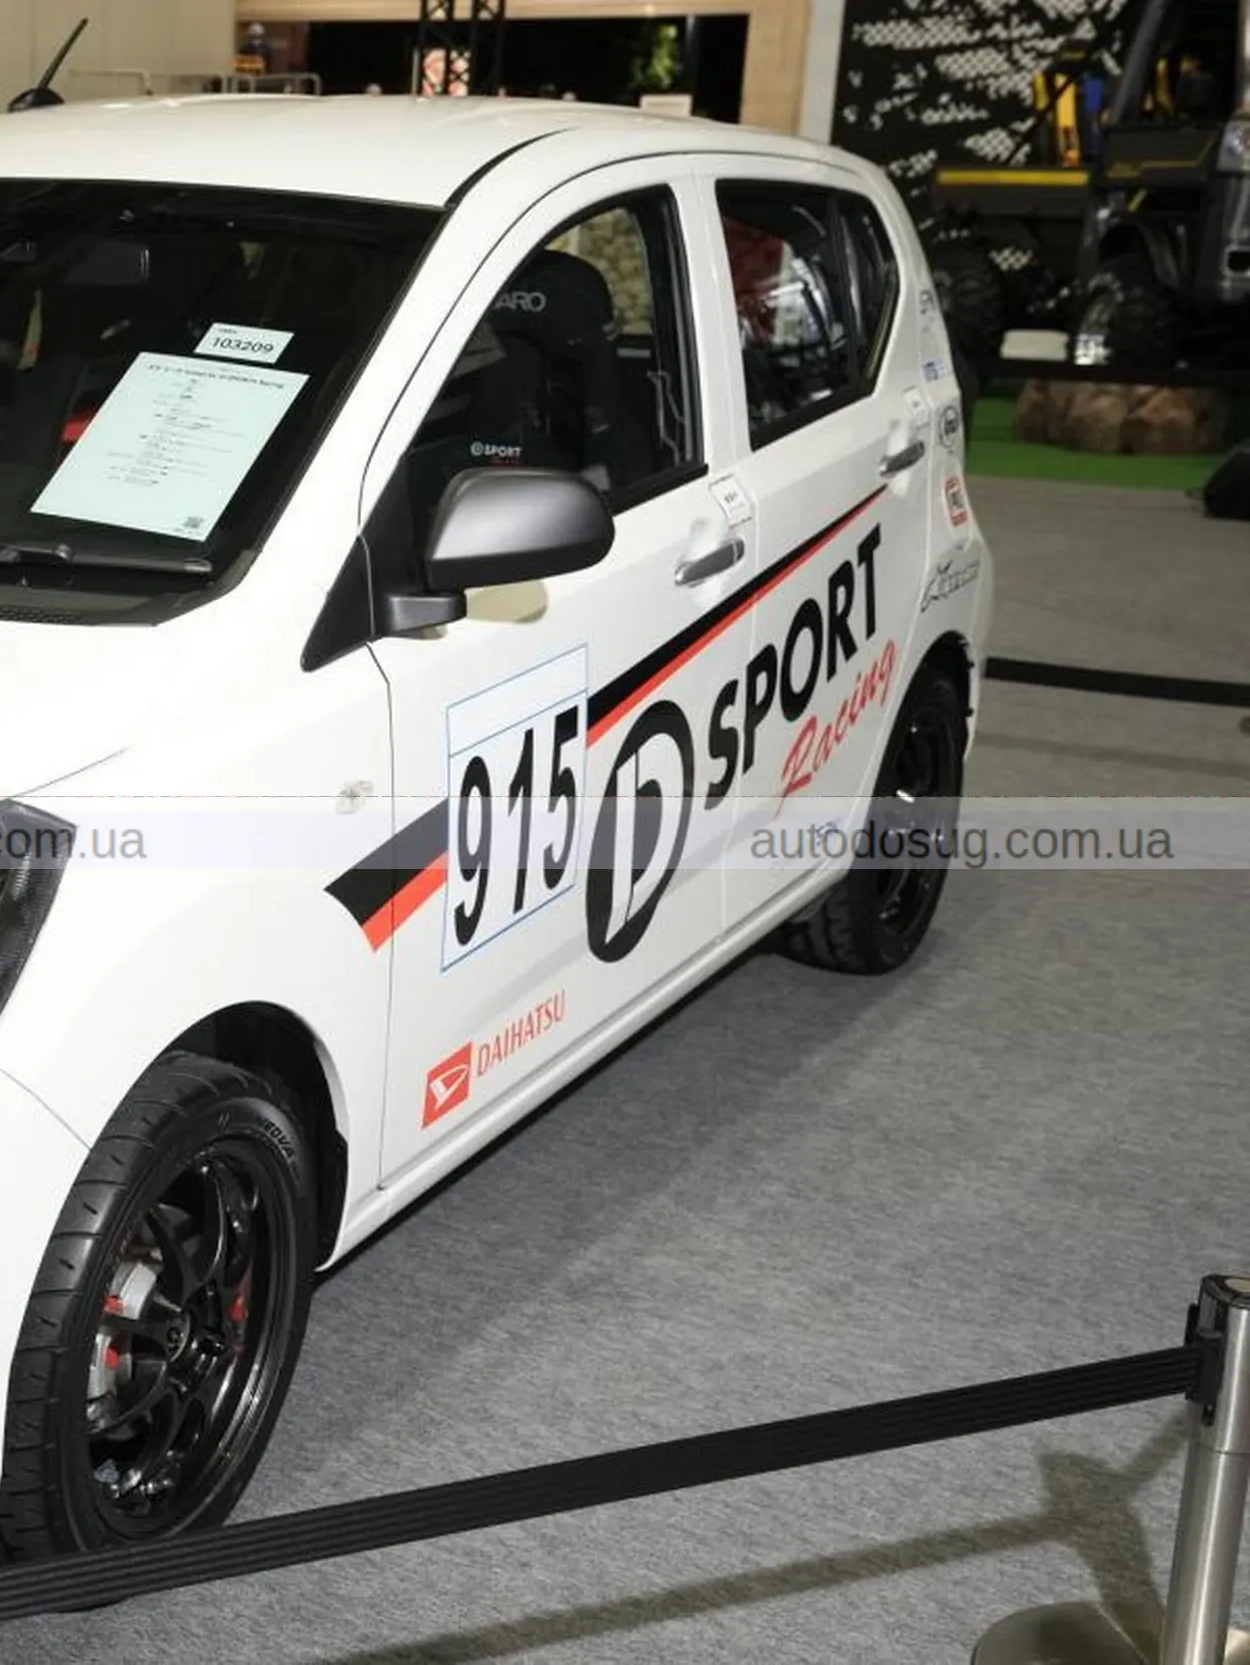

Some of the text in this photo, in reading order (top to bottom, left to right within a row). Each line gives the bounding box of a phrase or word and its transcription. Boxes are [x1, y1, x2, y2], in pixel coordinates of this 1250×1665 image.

[212, 336, 275, 353] 103209
[493, 291, 547, 312] ARO
[704, 522, 882, 811] SPORT
[773, 639, 897, 819] Racing
[454, 703, 579, 946] 915
[476, 989, 566, 1077] DAIHATSU
